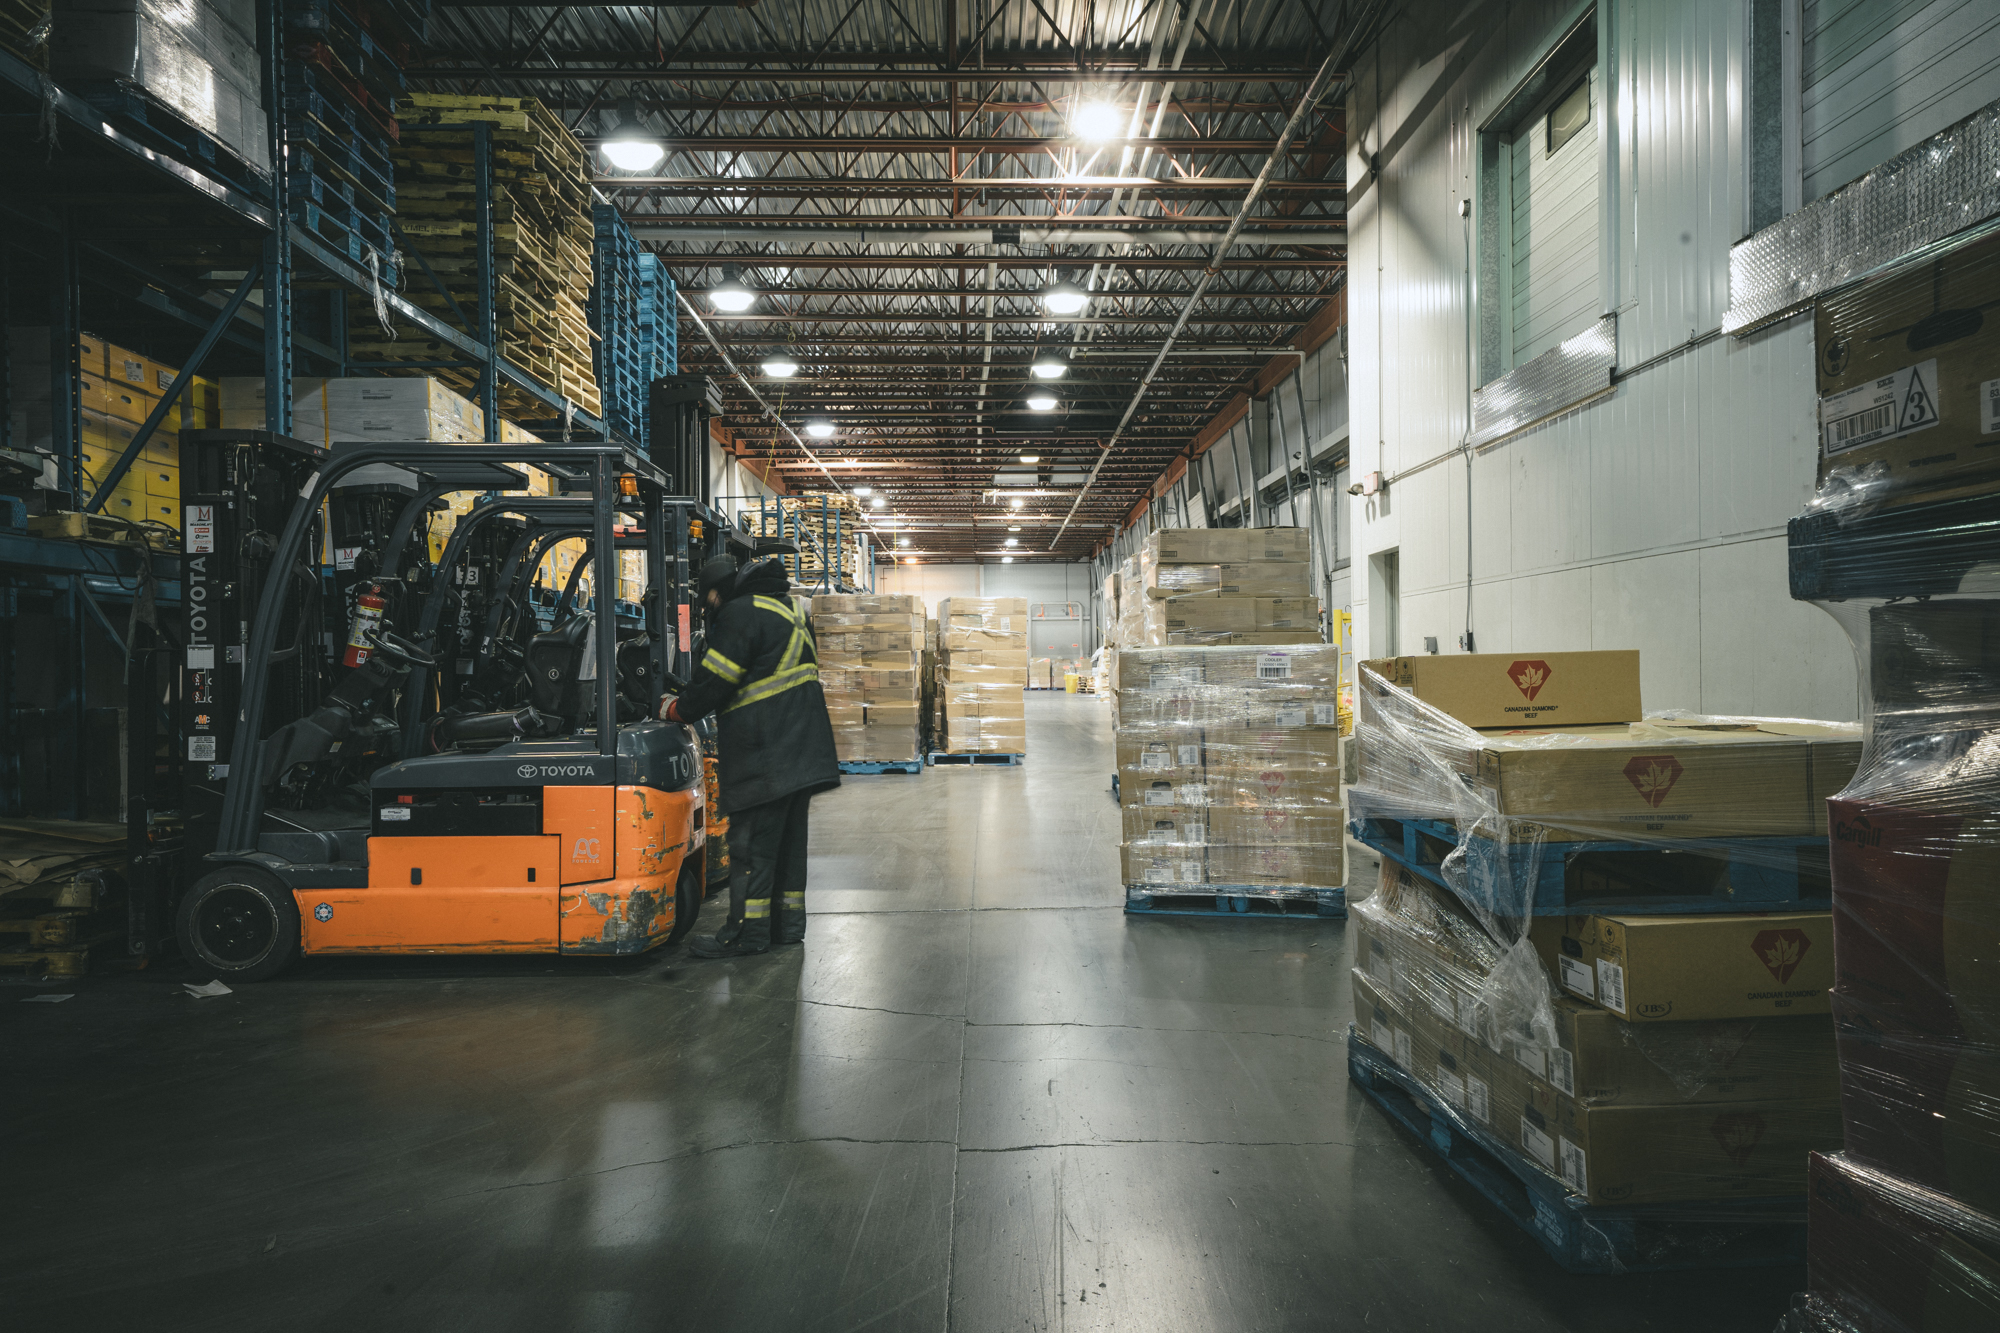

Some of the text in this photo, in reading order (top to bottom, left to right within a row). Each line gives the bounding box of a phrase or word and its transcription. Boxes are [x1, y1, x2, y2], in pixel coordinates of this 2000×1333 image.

[1910, 392, 1925, 422] 3
[189, 556, 207, 645] TOYOTA
[194, 714, 210, 724] AMC
[539, 765, 595, 777] TOYOTA
[1619, 815, 1655, 823] CANADIAN
[1836, 819, 1884, 848] Cargill
[573, 838, 599, 859] AC
[1747, 991, 1783, 1000] CANADIAN
[1642, 1004, 1665, 1013] JBS
[1718, 1085, 1736, 1093] BEEF
[1604, 1187, 1627, 1196] JBS
